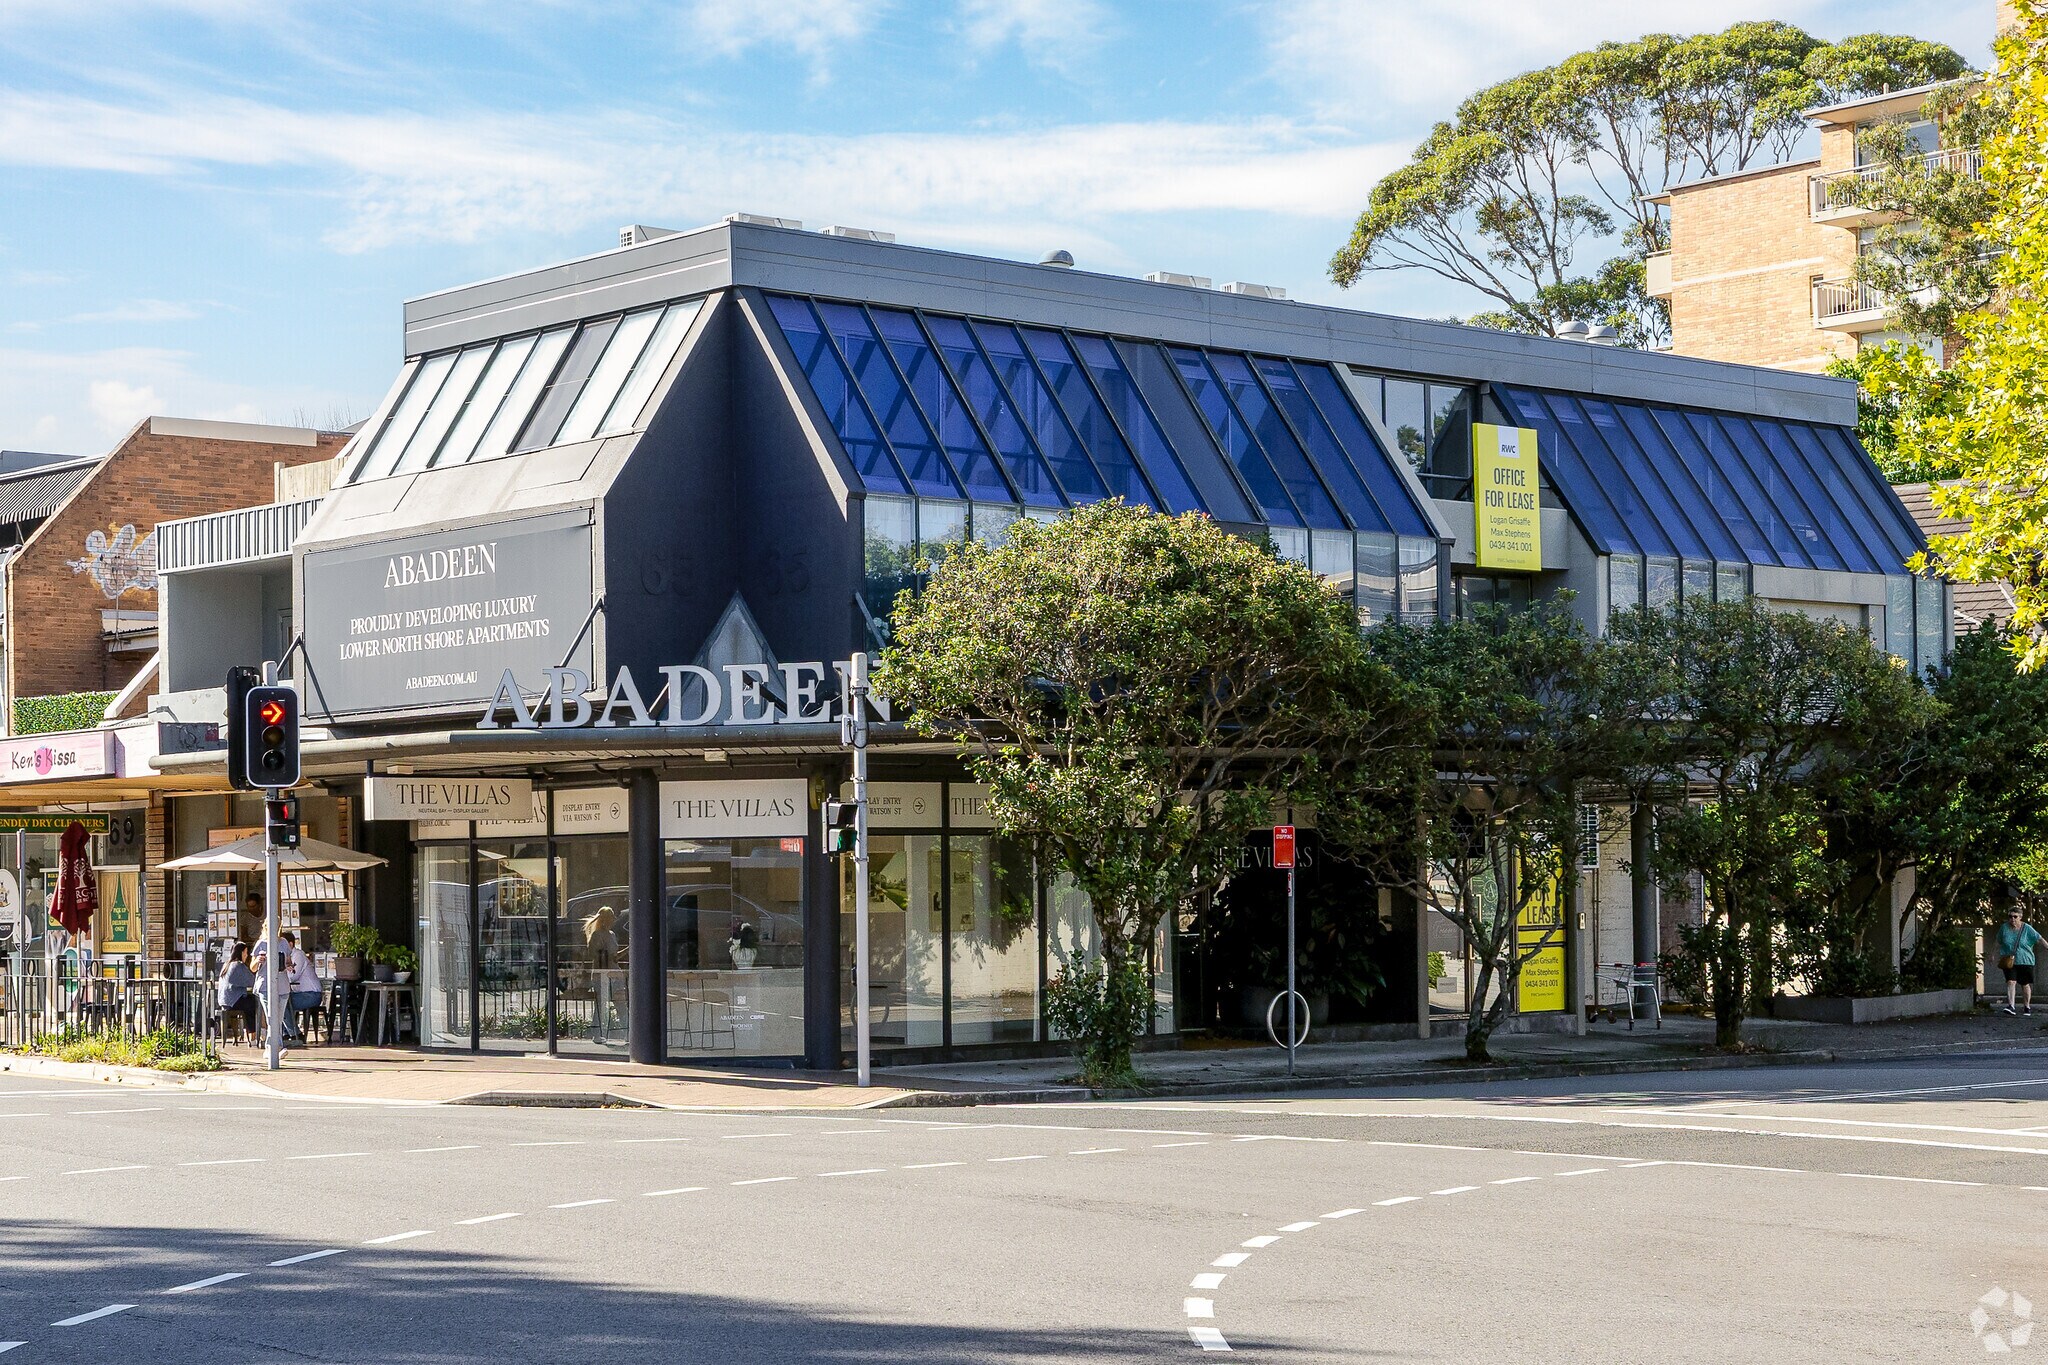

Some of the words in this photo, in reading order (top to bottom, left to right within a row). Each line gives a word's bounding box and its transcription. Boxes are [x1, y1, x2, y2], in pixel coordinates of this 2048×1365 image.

[1501, 444, 1516, 454] RWC
[1493, 467, 1526, 486] OFFICE
[1485, 489, 1504, 508] FOR
[1507, 491, 1535, 510] LEASE
[1490, 515, 1508, 526] Logan
[1490, 528, 1503, 537] Max
[1504, 528, 1531, 539] Stephens
[1489, 540, 1505, 549] 0434
[1506, 541, 1519, 550] 341
[1520, 542, 1533, 552] 001
[383, 542, 498, 589] ABADEEN
[349, 612, 403, 636] PROUDLY
[404, 602, 482, 629] DEVELOPING
[484, 594, 538, 618] LUXURY
[339, 640, 381, 660] LOWER
[381, 634, 423, 655] NORTH
[424, 630, 464, 651] SHORE
[465, 618, 550, 646] APARTMENTS
[405, 670, 479, 690] ABADEEN.COM.AU
[476, 661, 891, 729] ABADEEN
[11, 750, 42, 770] Ken's
[45, 748, 77, 767] Kissa
[396, 784, 438, 805] THE
[441, 784, 511, 806] VILLAS
[883, 797, 901, 805] ENTRY
[562, 804, 583, 813] DISPLAY
[585, 803, 601, 811] ENTRY
[672, 799, 717, 819] THE
[720, 798, 795, 818] VILLAS
[869, 807, 892, 815] WATSON
[894, 807, 901, 815] ST
[951, 797, 983, 816] THE
[32, 818, 52, 828] DRY
[53, 818, 105, 828] CLENERS
[562, 814, 573, 822] VIA
[574, 813, 593, 822] WATSON
[594, 812, 601, 821] ST
[109, 817, 135, 845] 69
[1254, 846, 1313, 868] VIAS
[1537, 968, 1559, 977] Stephens
[1525, 980, 1538, 988] 0434
[1549, 979, 1559, 987] 001
